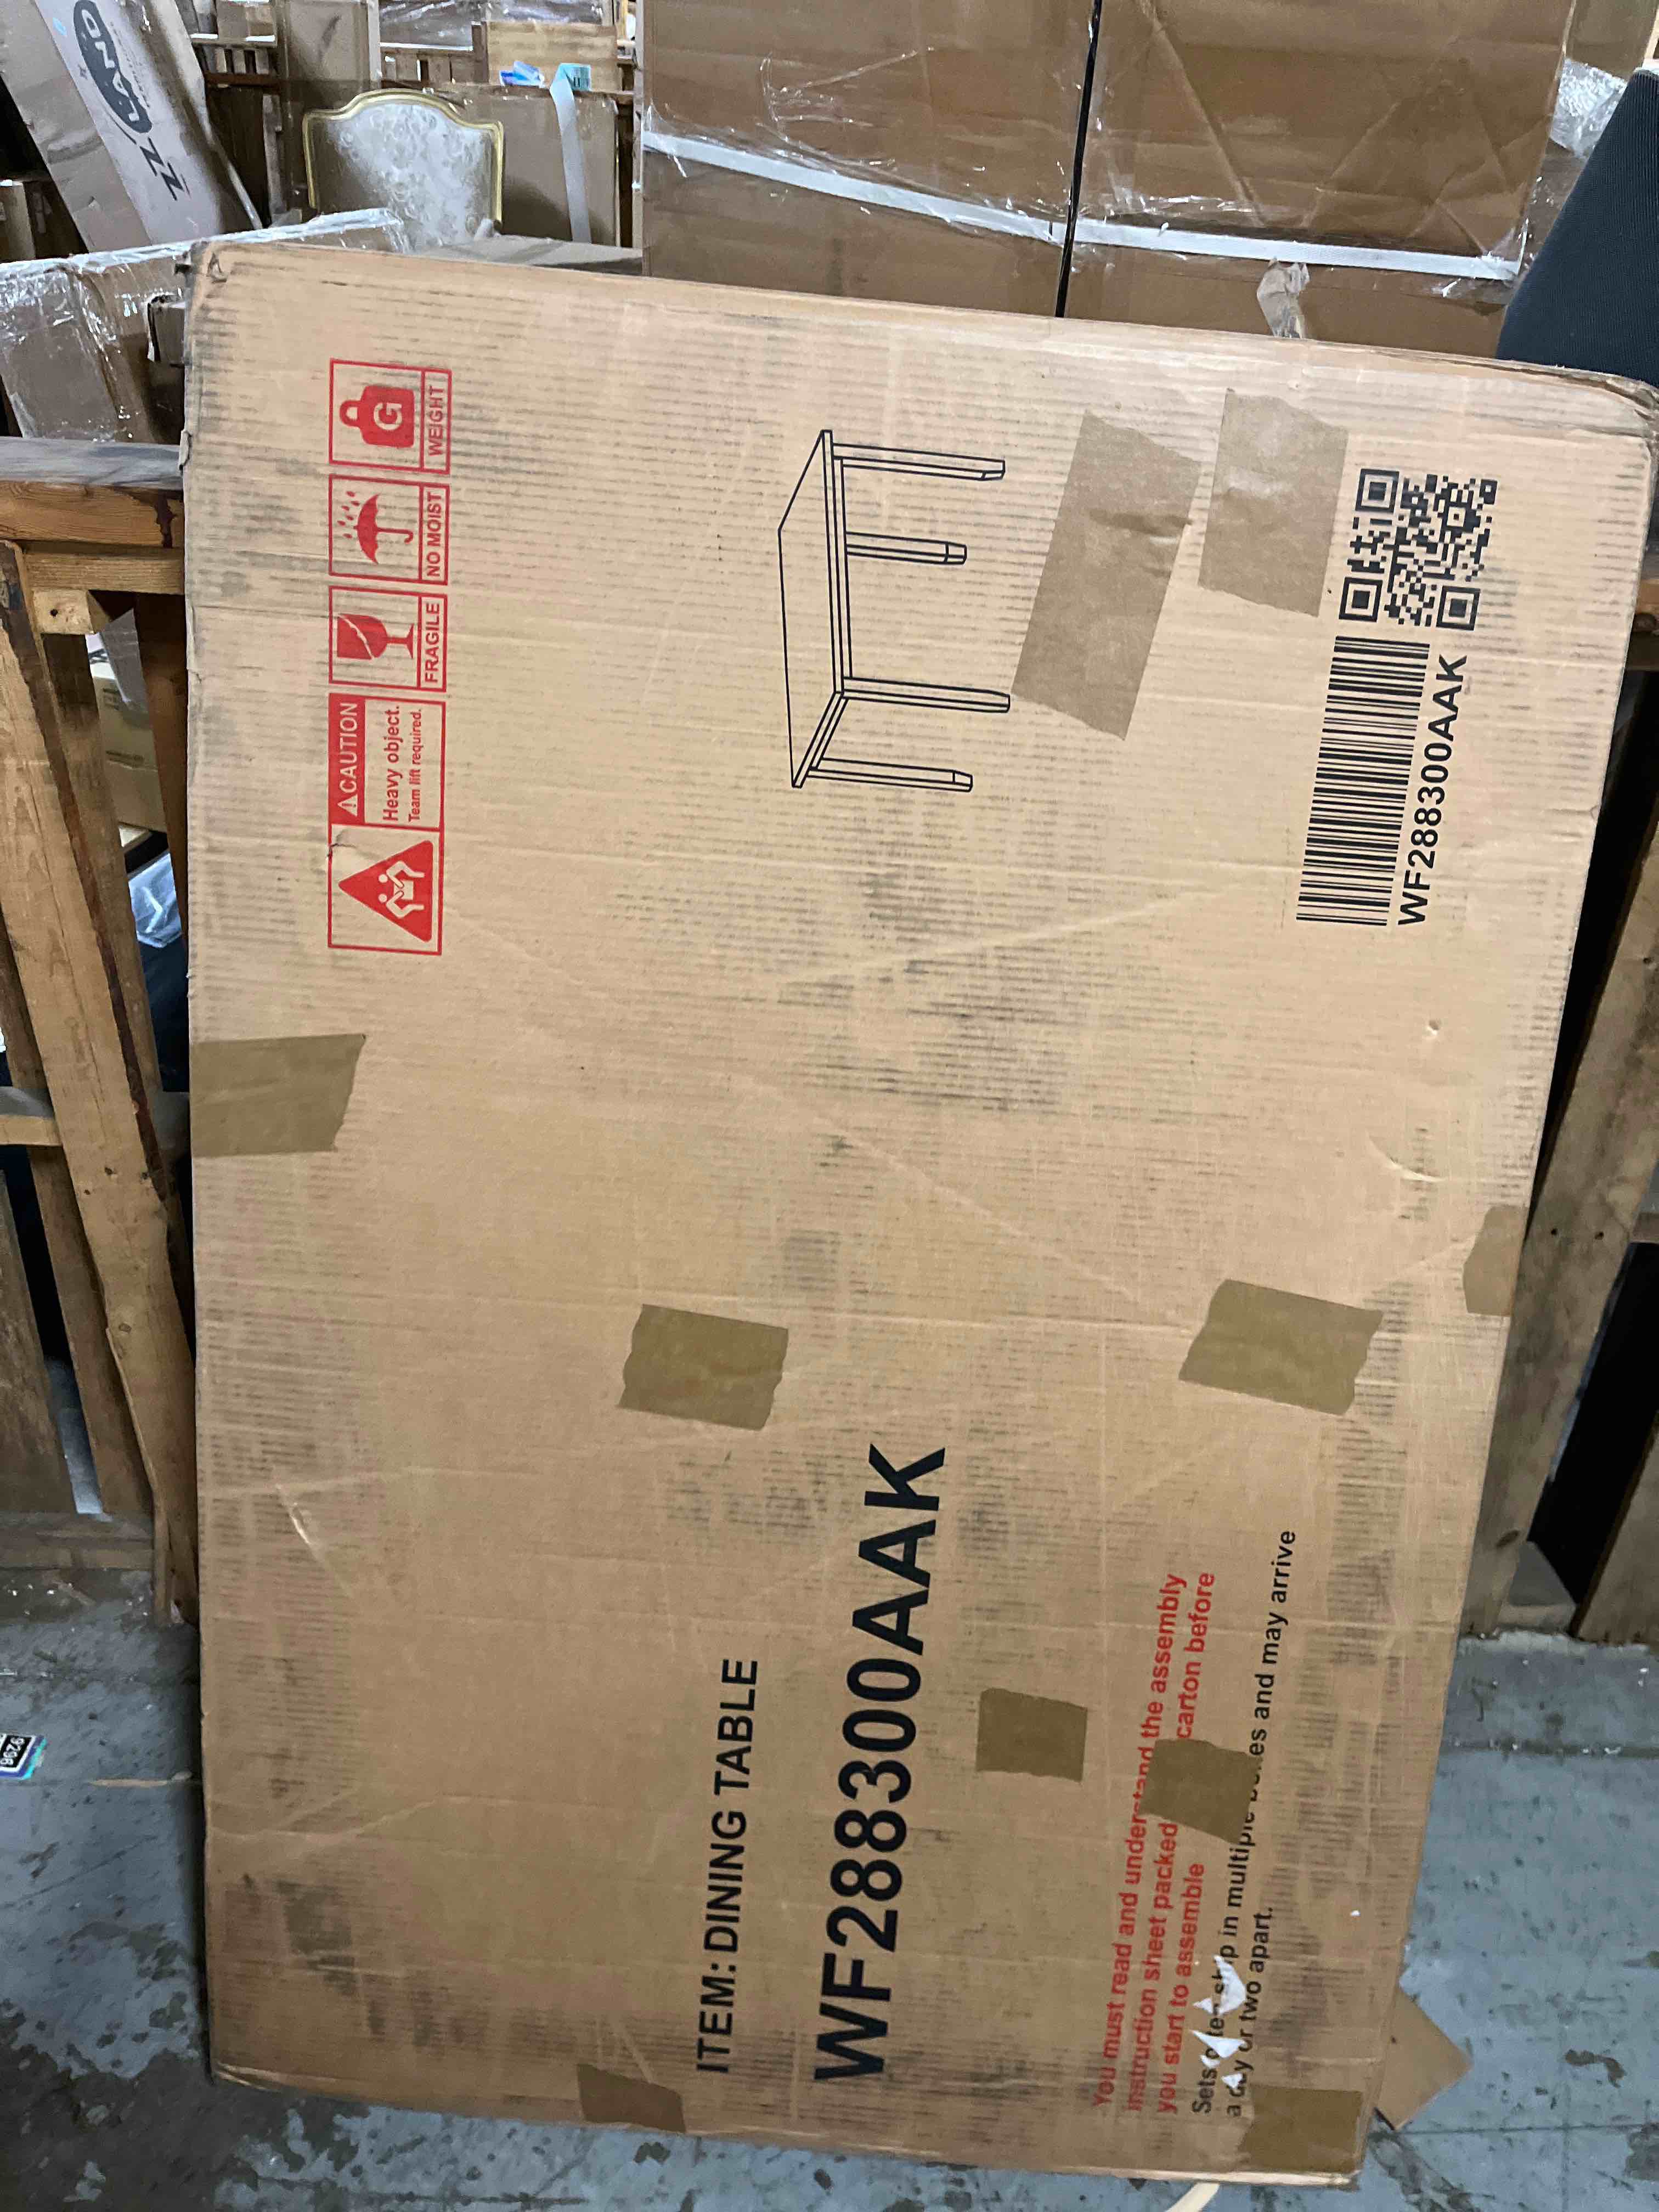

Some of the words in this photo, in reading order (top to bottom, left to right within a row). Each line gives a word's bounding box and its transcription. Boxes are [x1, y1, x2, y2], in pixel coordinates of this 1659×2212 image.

[429, 386, 444, 456] WEIGHT
[427, 492, 442, 545] MOIST
[427, 554, 441, 576] NO
[425, 603, 439, 683] FRAGILE
[340, 703, 357, 792] CAUTION
[385, 706, 403, 766] object.
[411, 709, 423, 765] required.
[383, 769, 403, 821] Heavy
[408, 769, 420, 785] lift
[409, 789, 420, 821] Team
[1398, 654, 1467, 925] WF288300AAK
[1271, 1531, 1295, 1603] arrive
[1151, 1574, 1187, 1693] assembly
[1184, 1572, 1215, 1652] before
[1262, 1612, 1288, 1664] may
[1141, 1703, 1163, 1739] the
[1177, 1662, 1201, 1738] carton
[1255, 1674, 1274, 1719] and
[715, 1660, 758, 1795] TABLE
[814, 1443, 945, 2080] WF288300AAK
[704, 1812, 746, 1952] DINING
[1153, 1823, 1178, 1909] packed
[1119, 1893, 1138, 1937] and
[1176, 1863, 1204, 1977] assemble
[1250, 1907, 1273, 1973] apart.
[1112, 1944, 1132, 1994] read
[1142, 1917, 1167, 1980] sheet
[697, 1963, 737, 2073] ITEM:
[1169, 1984, 1189, 2008] to
[1192, 2068, 1217, 2114] Sets
[1220, 1916, 1238, 1937] in
[1239, 1980, 1261, 2023] two
[1102, 2004, 1124, 2058] must
[1127, 1989, 1158, 2111] instruction
[1162, 2013, 1186, 2064] start
[1239, 2030, 1252, 2053] or
[1157, 2073, 1177, 2114] you
[1227, 2104, 1240, 2117] a
